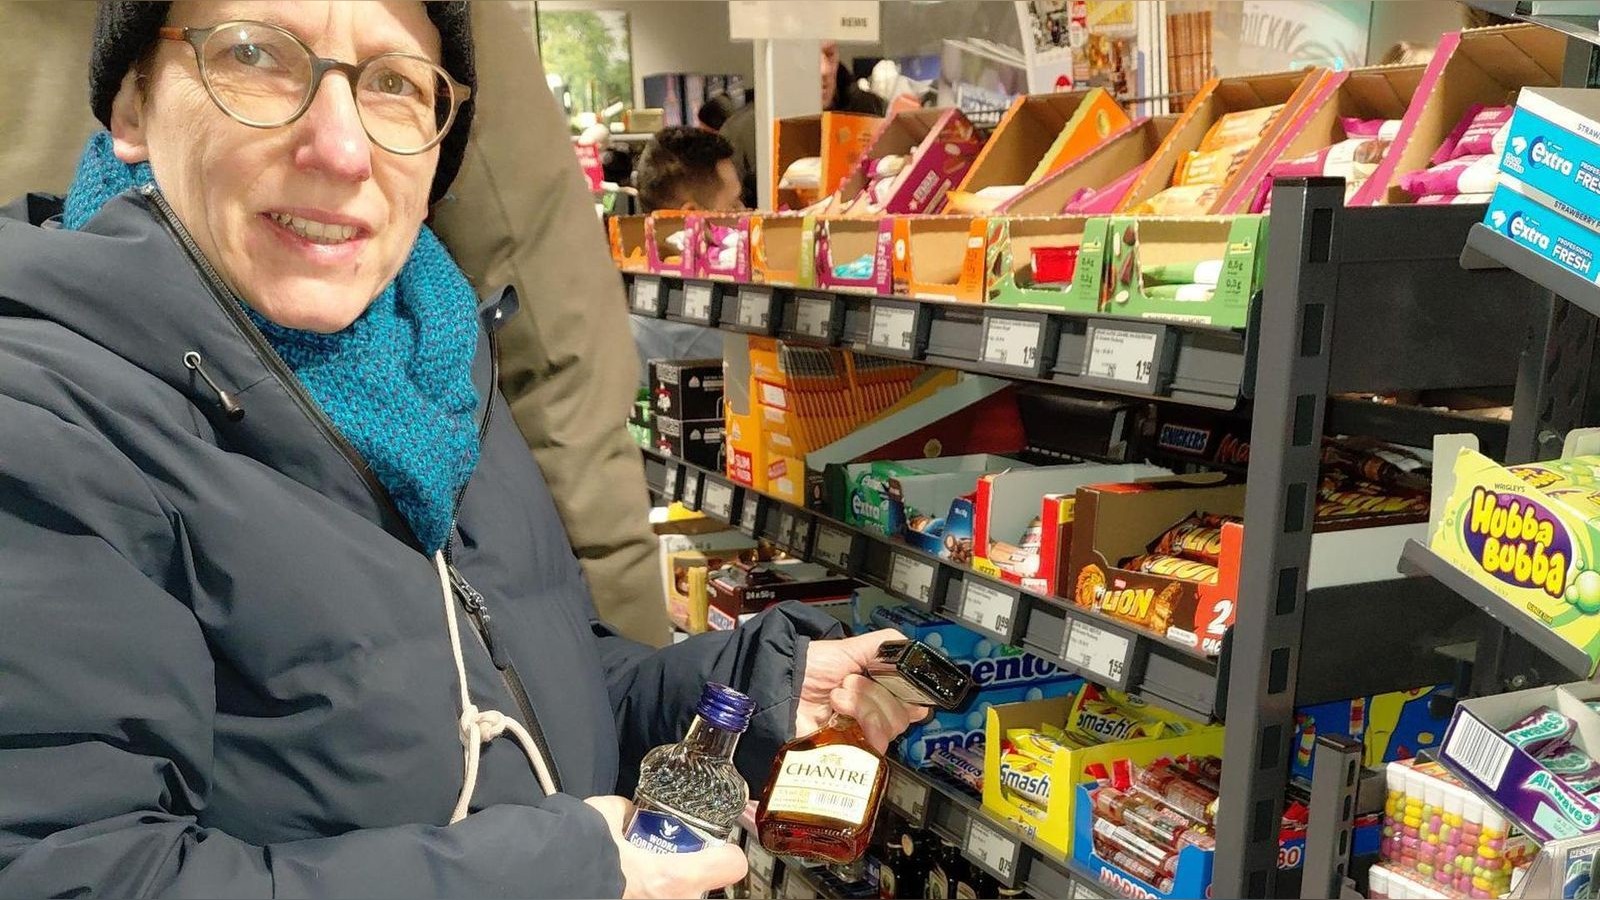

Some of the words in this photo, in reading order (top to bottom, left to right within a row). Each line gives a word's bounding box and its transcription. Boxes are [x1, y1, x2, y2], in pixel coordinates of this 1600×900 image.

[1531, 142, 1573, 176] extra
[1574, 170, 1600, 195] FRES
[1510, 216, 1550, 250] extra
[1552, 245, 1591, 273] FRESH
[1135, 360, 1152, 381] 1.19
[1161, 426, 1208, 451] SNICKERS
[1494, 483, 1525, 493] WRIGLEY'S
[852, 495, 880, 520] extra
[1470, 488, 1554, 548] Hubba
[1182, 527, 1222, 554] LIO
[1482, 536, 1566, 596] Bubba
[1101, 588, 1154, 619] LION
[995, 614, 1009, 632] 0.99
[1207, 599, 1233, 635] 2
[1201, 637, 1222, 655] PAC
[1109, 659, 1124, 678] 1.55
[1509, 712, 1564, 744] rwaves
[785, 762, 870, 786] CHANTRÉ
[1527, 772, 1593, 826] Airwaves
[649, 833, 679, 853] WODKA
